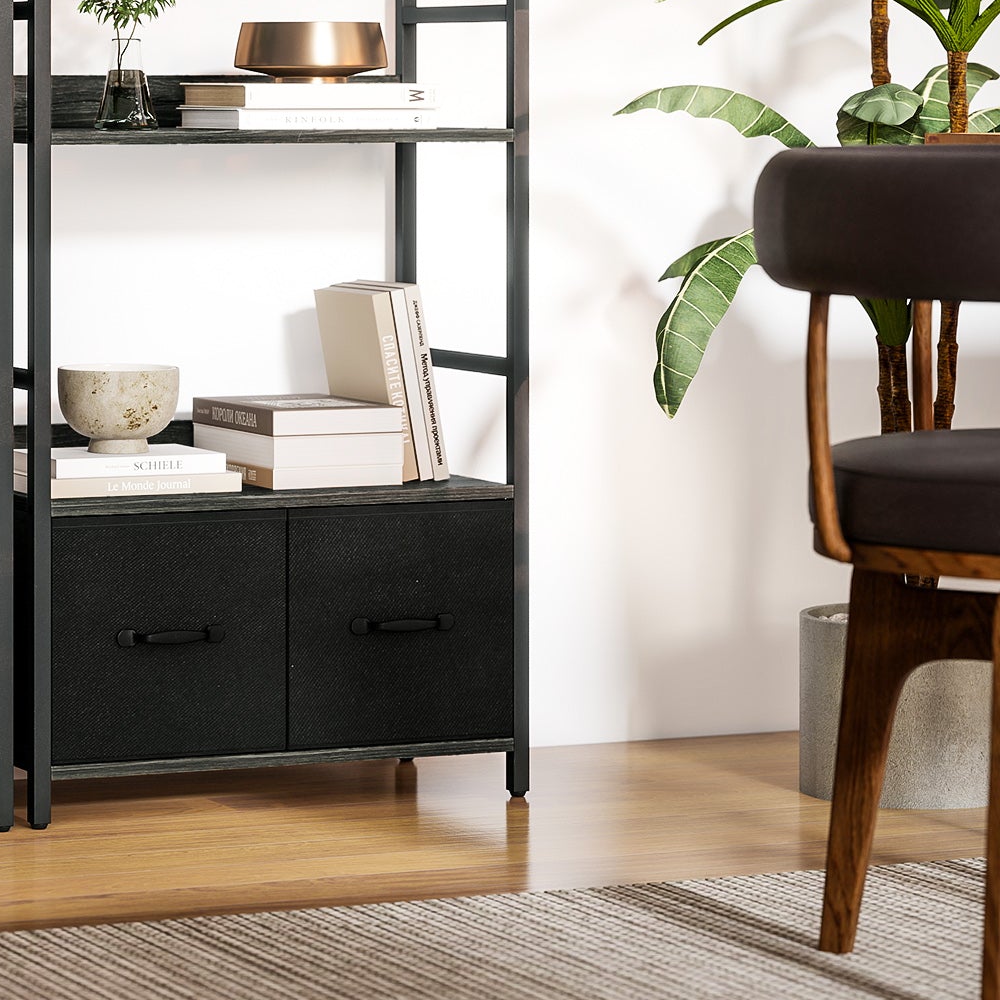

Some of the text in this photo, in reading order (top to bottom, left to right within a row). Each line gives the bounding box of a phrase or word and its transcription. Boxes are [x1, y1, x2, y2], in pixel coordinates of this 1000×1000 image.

[285, 115, 345, 124] KINFOLK
[382, 334, 402, 389] СПАСИТЕ
[211, 406, 234, 423] КОРОЛИ
[234, 410, 257, 428] ОКЕАНА
[420, 353, 444, 466] Метод управления проектами
[133, 460, 184, 471] SCHIELE
[107, 479, 191, 492] Le Monde Journal
